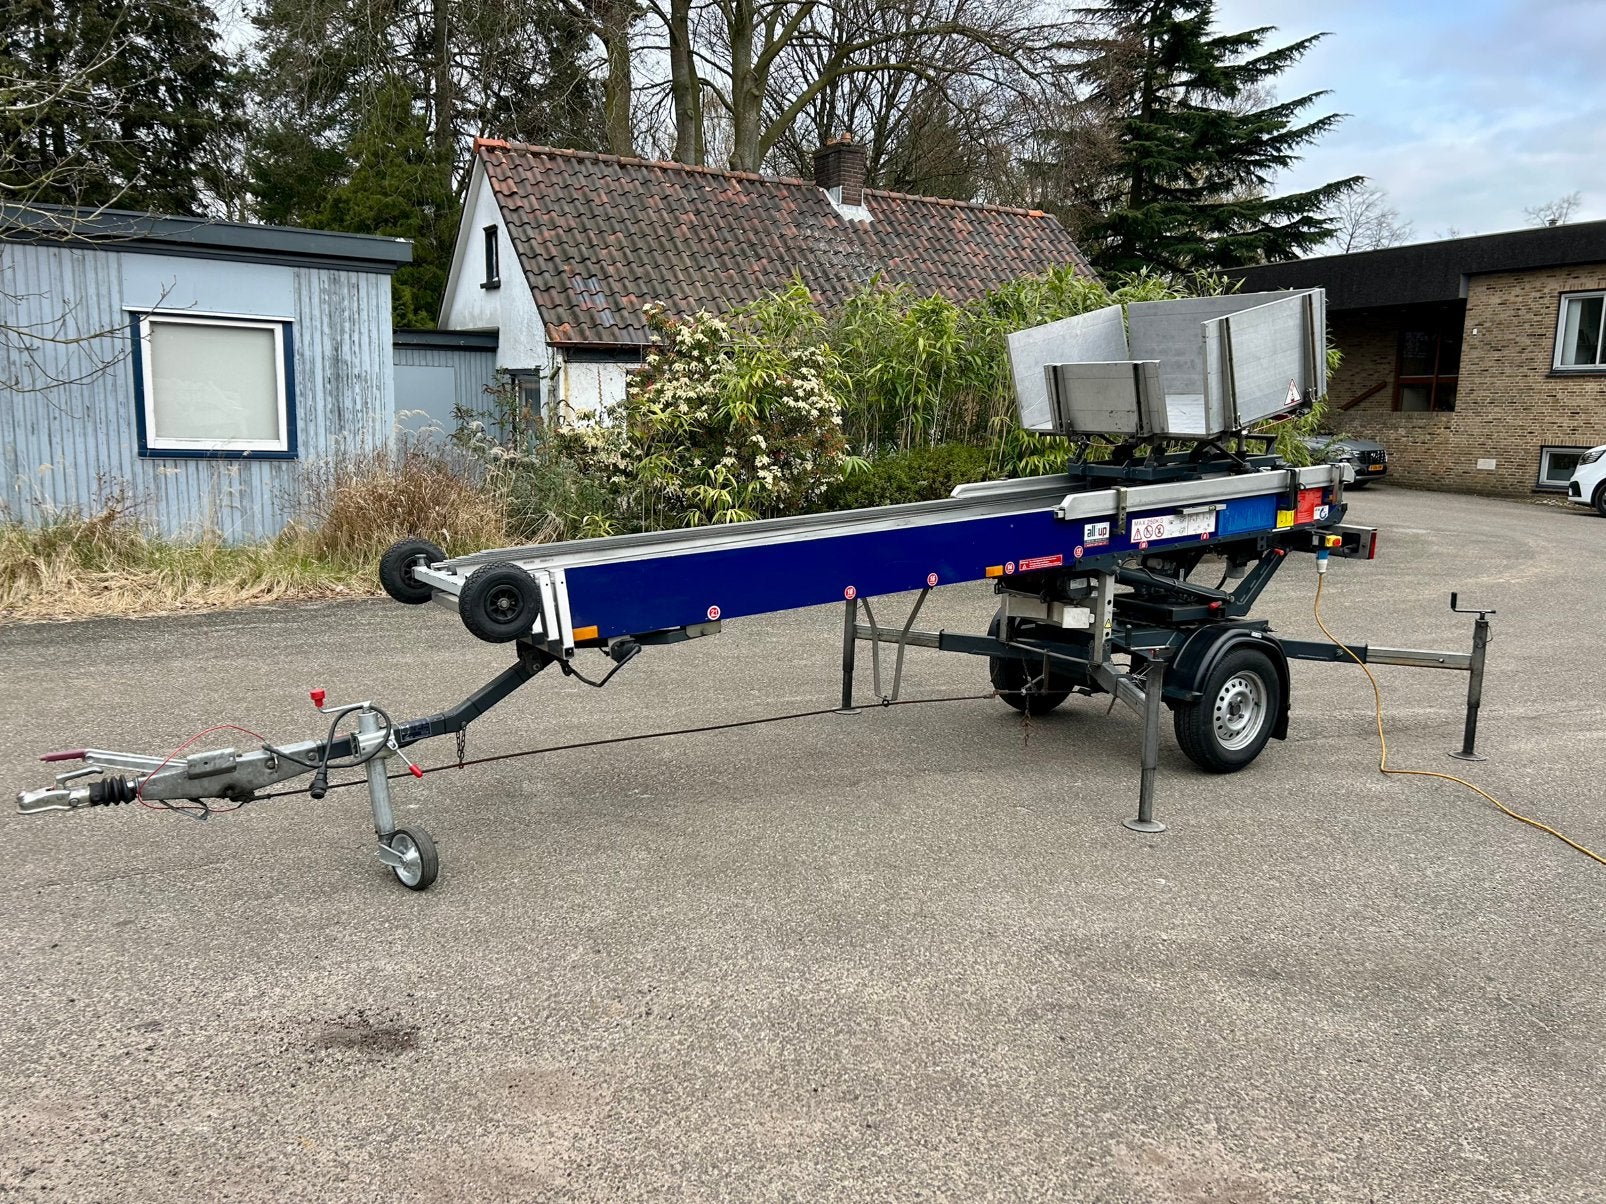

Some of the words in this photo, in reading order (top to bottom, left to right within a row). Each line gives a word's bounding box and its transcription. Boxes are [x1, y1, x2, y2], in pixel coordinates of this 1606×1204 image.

[1087, 525, 1096, 538] all
[1098, 527, 1107, 537] up
[710, 608, 718, 616] 21
